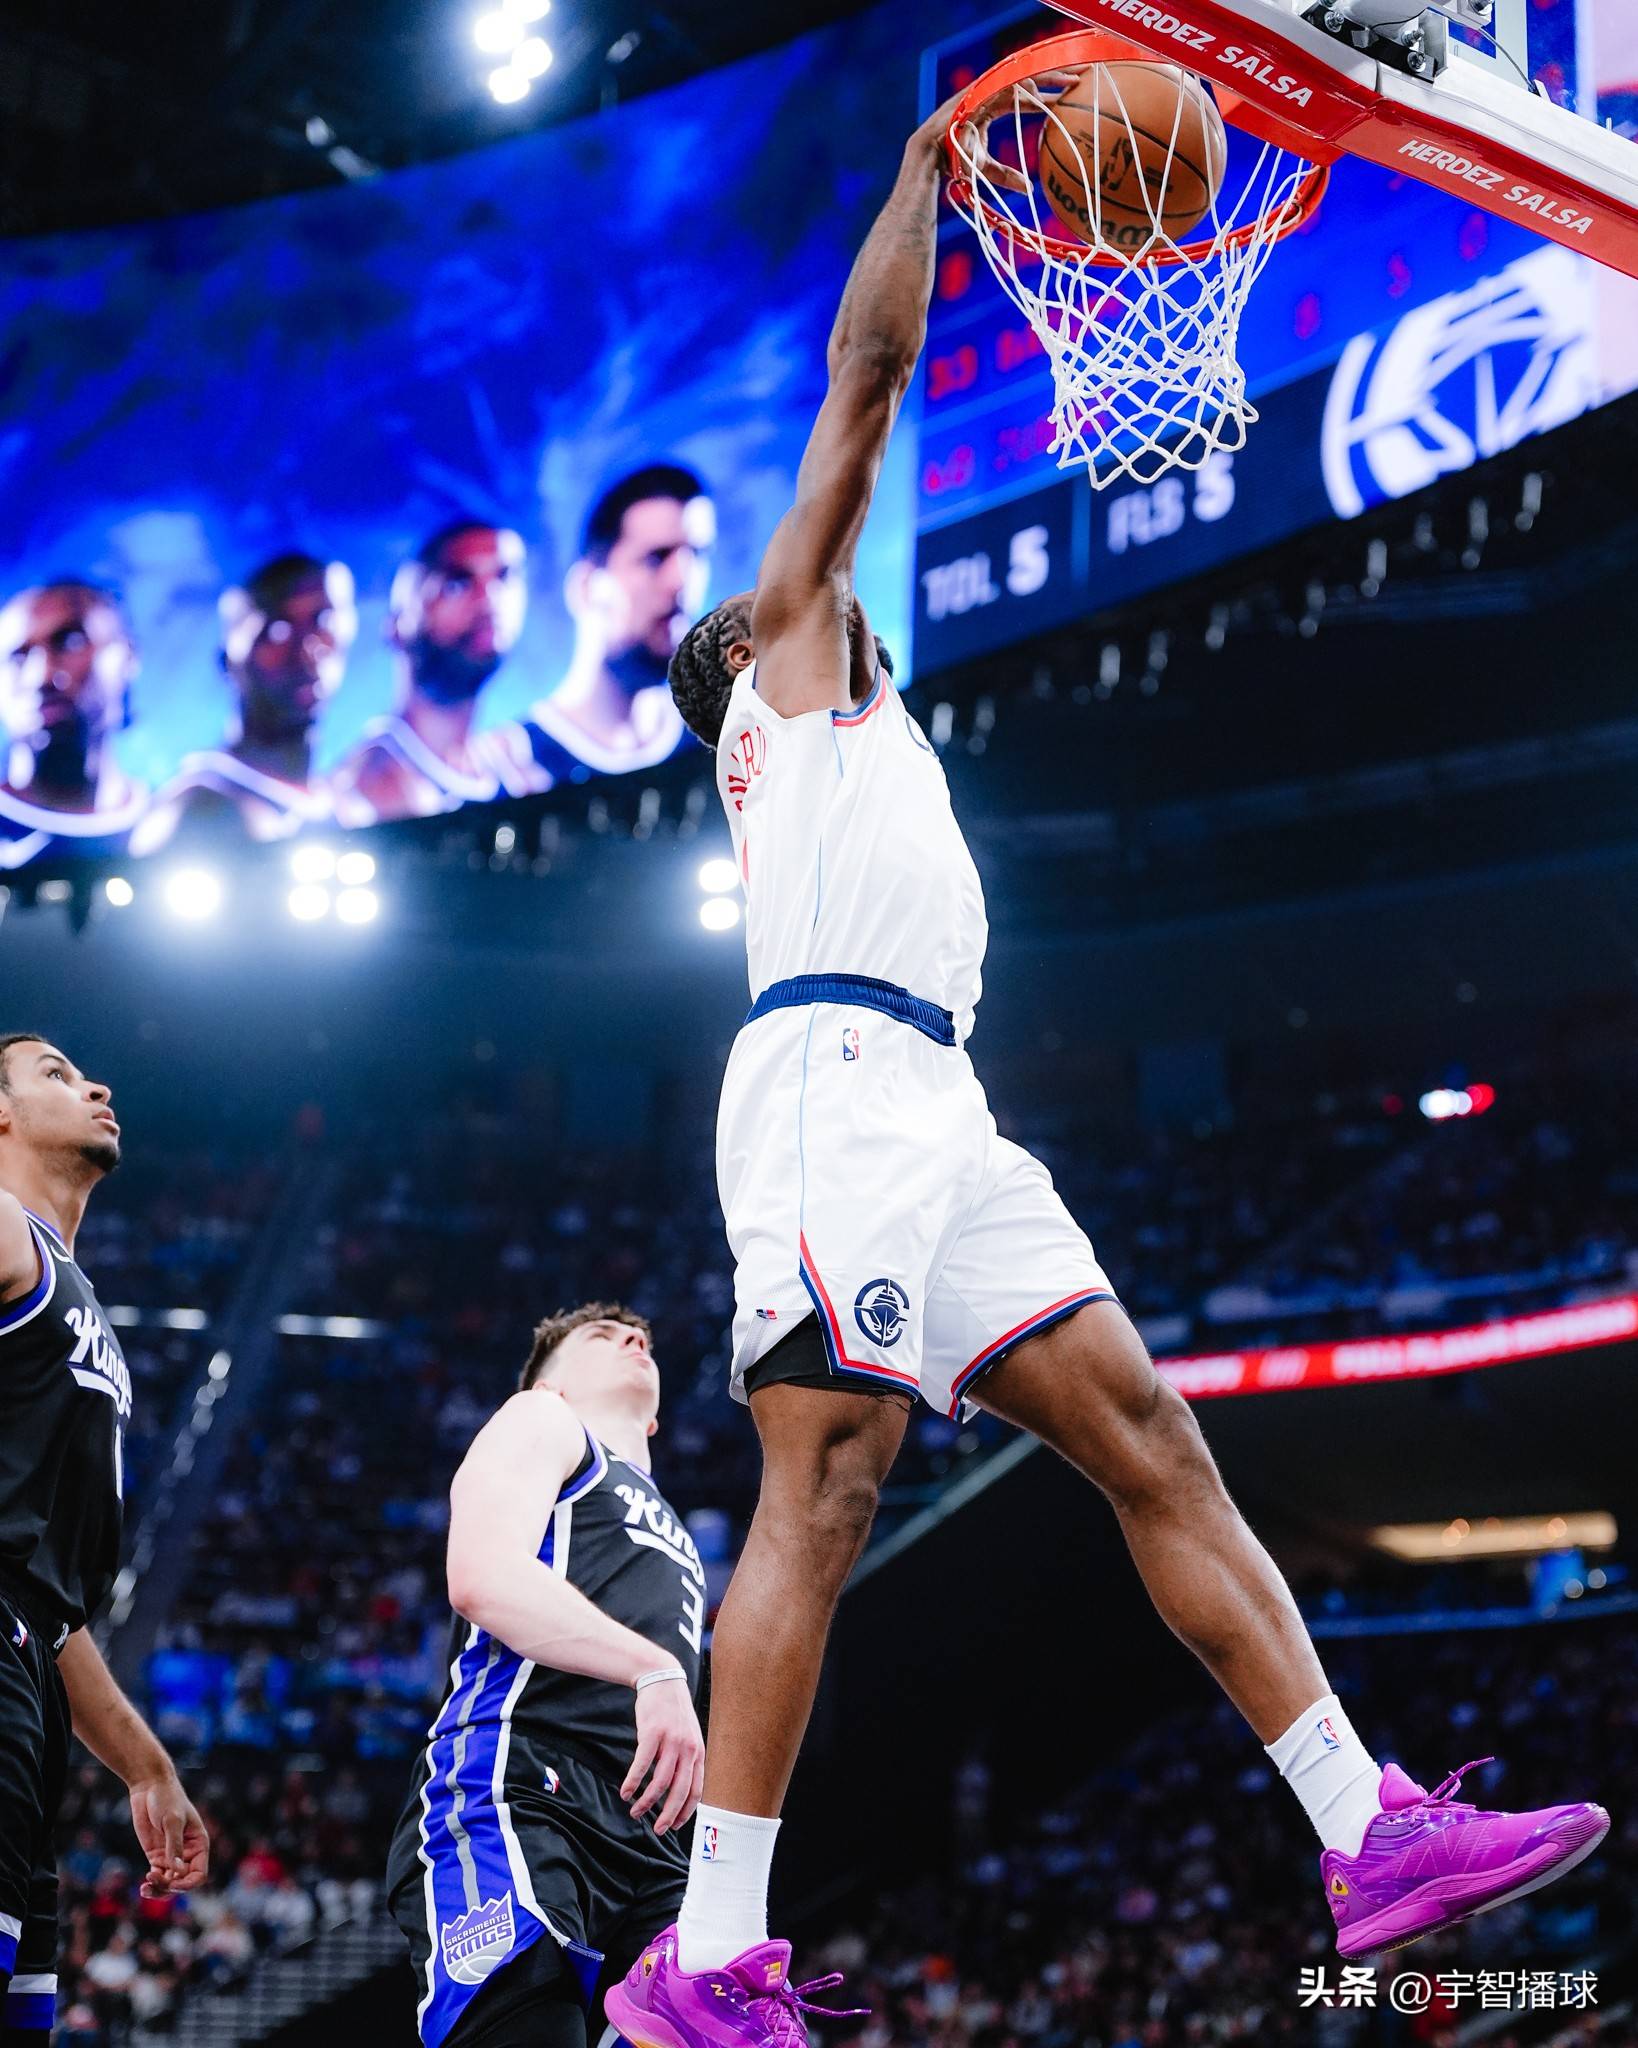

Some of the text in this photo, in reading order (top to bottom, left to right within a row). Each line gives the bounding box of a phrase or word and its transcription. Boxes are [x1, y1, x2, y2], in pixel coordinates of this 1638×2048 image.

[1216, 46, 1313, 108] SALSA
[1398, 140, 1504, 191] HERDEZ
[1502, 185, 1594, 235] SALSA
[1007, 525, 1049, 596] 5
[446, 1913, 508, 1947] SACRAMENTO
[446, 1922, 513, 1966] KINGS
